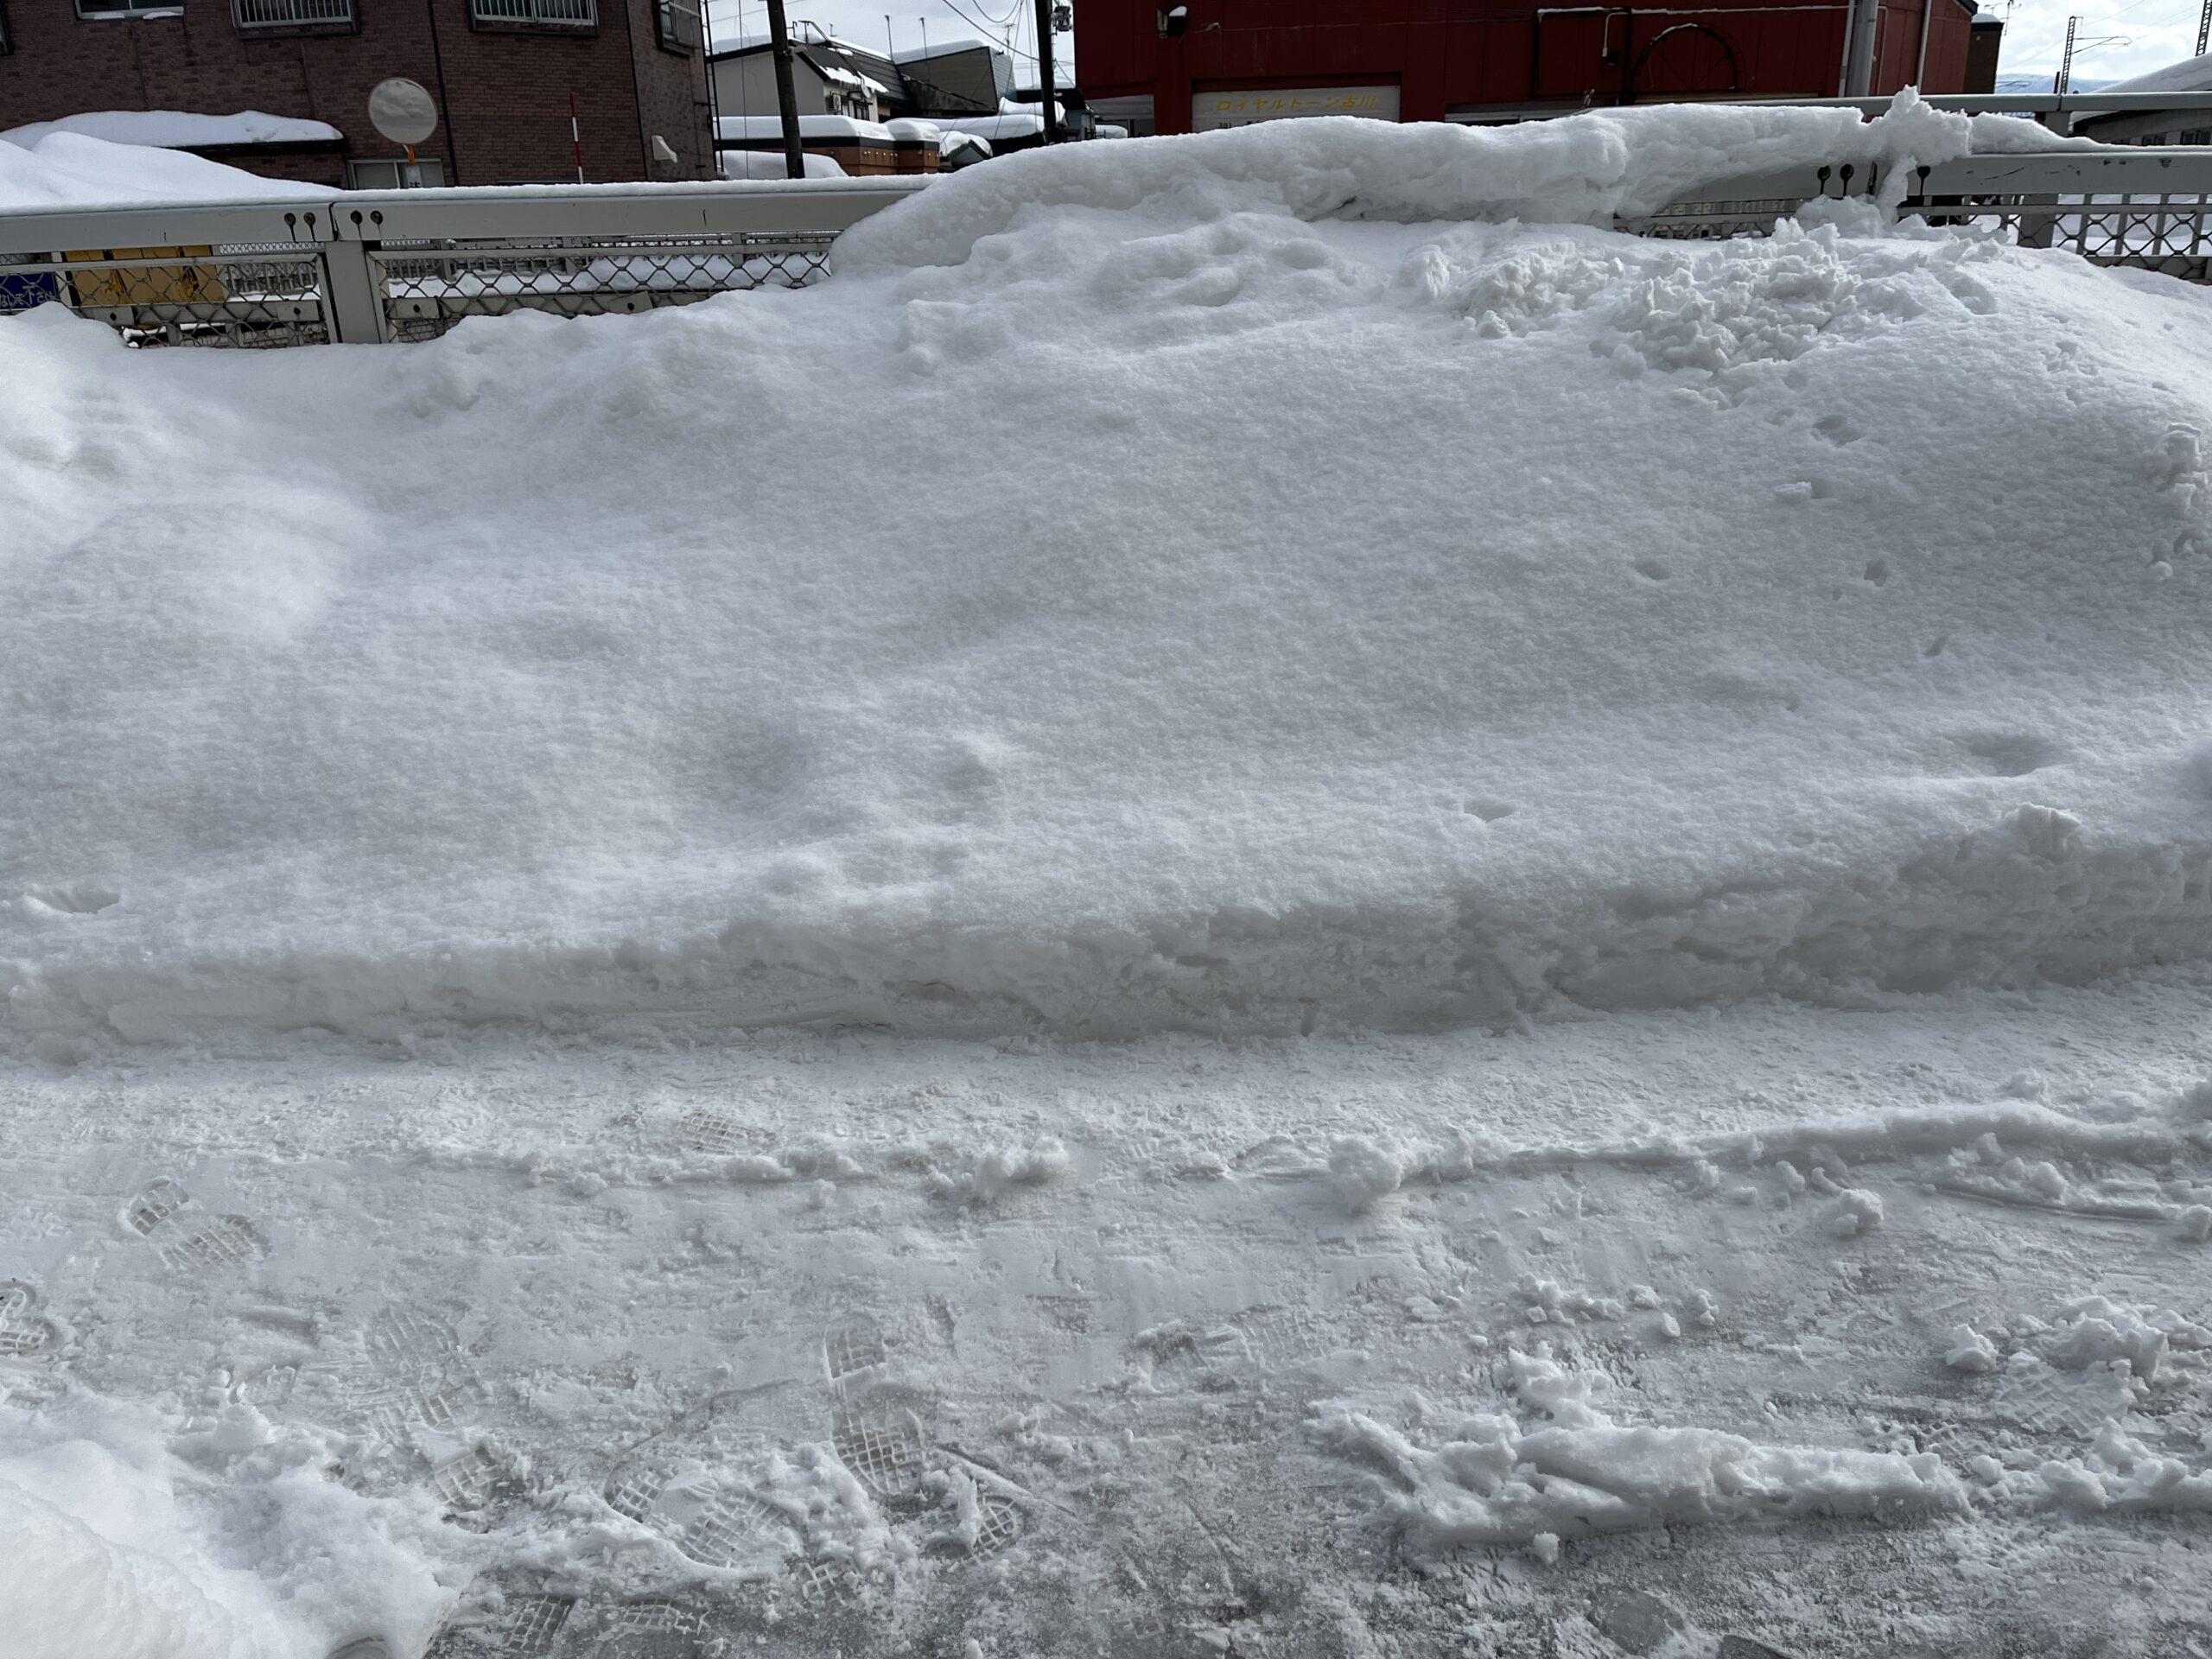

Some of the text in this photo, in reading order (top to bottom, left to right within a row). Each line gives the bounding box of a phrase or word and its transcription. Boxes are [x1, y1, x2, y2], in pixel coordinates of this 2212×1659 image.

[1216, 95, 1377, 111] ロイヤルトーン古川
